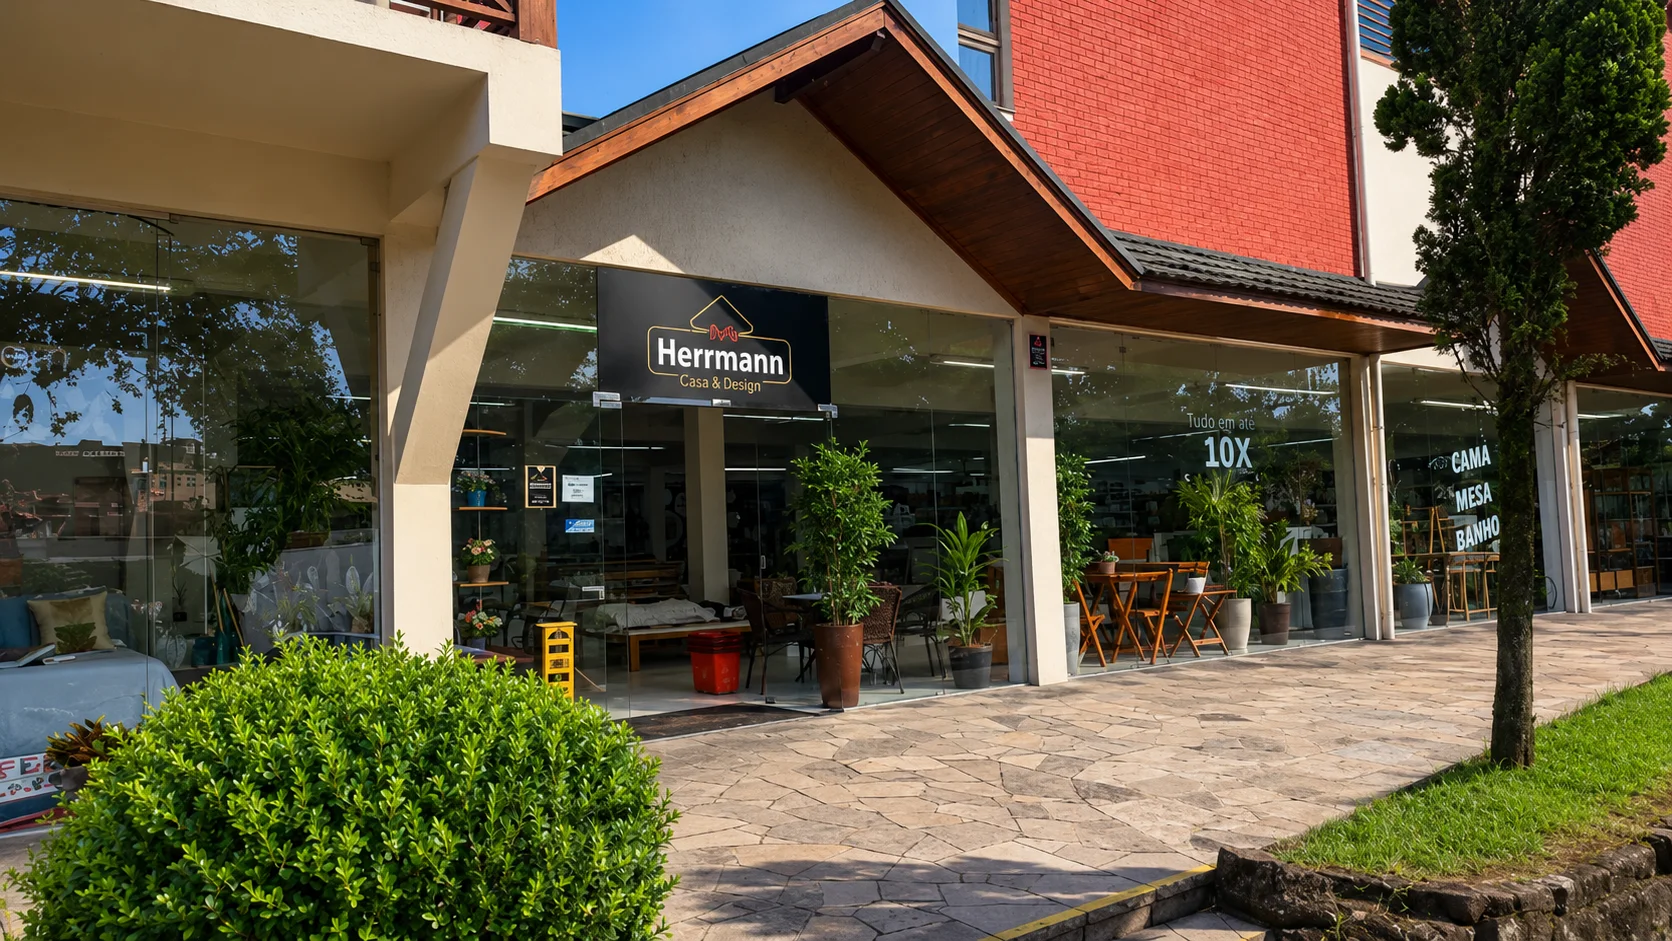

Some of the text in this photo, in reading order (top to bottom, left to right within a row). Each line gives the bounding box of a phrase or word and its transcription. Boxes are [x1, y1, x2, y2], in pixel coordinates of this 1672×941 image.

[658, 337, 783, 375] Herrmann
[680, 374, 761, 394] Casa & Design
[1186, 412, 1215, 429] Tudo
[1218, 418, 1235, 430] em
[1204, 436, 1253, 468] 10X
[1451, 444, 1491, 474] CAMA
[1455, 482, 1493, 512] MESA
[1455, 514, 1500, 552] BANHO
